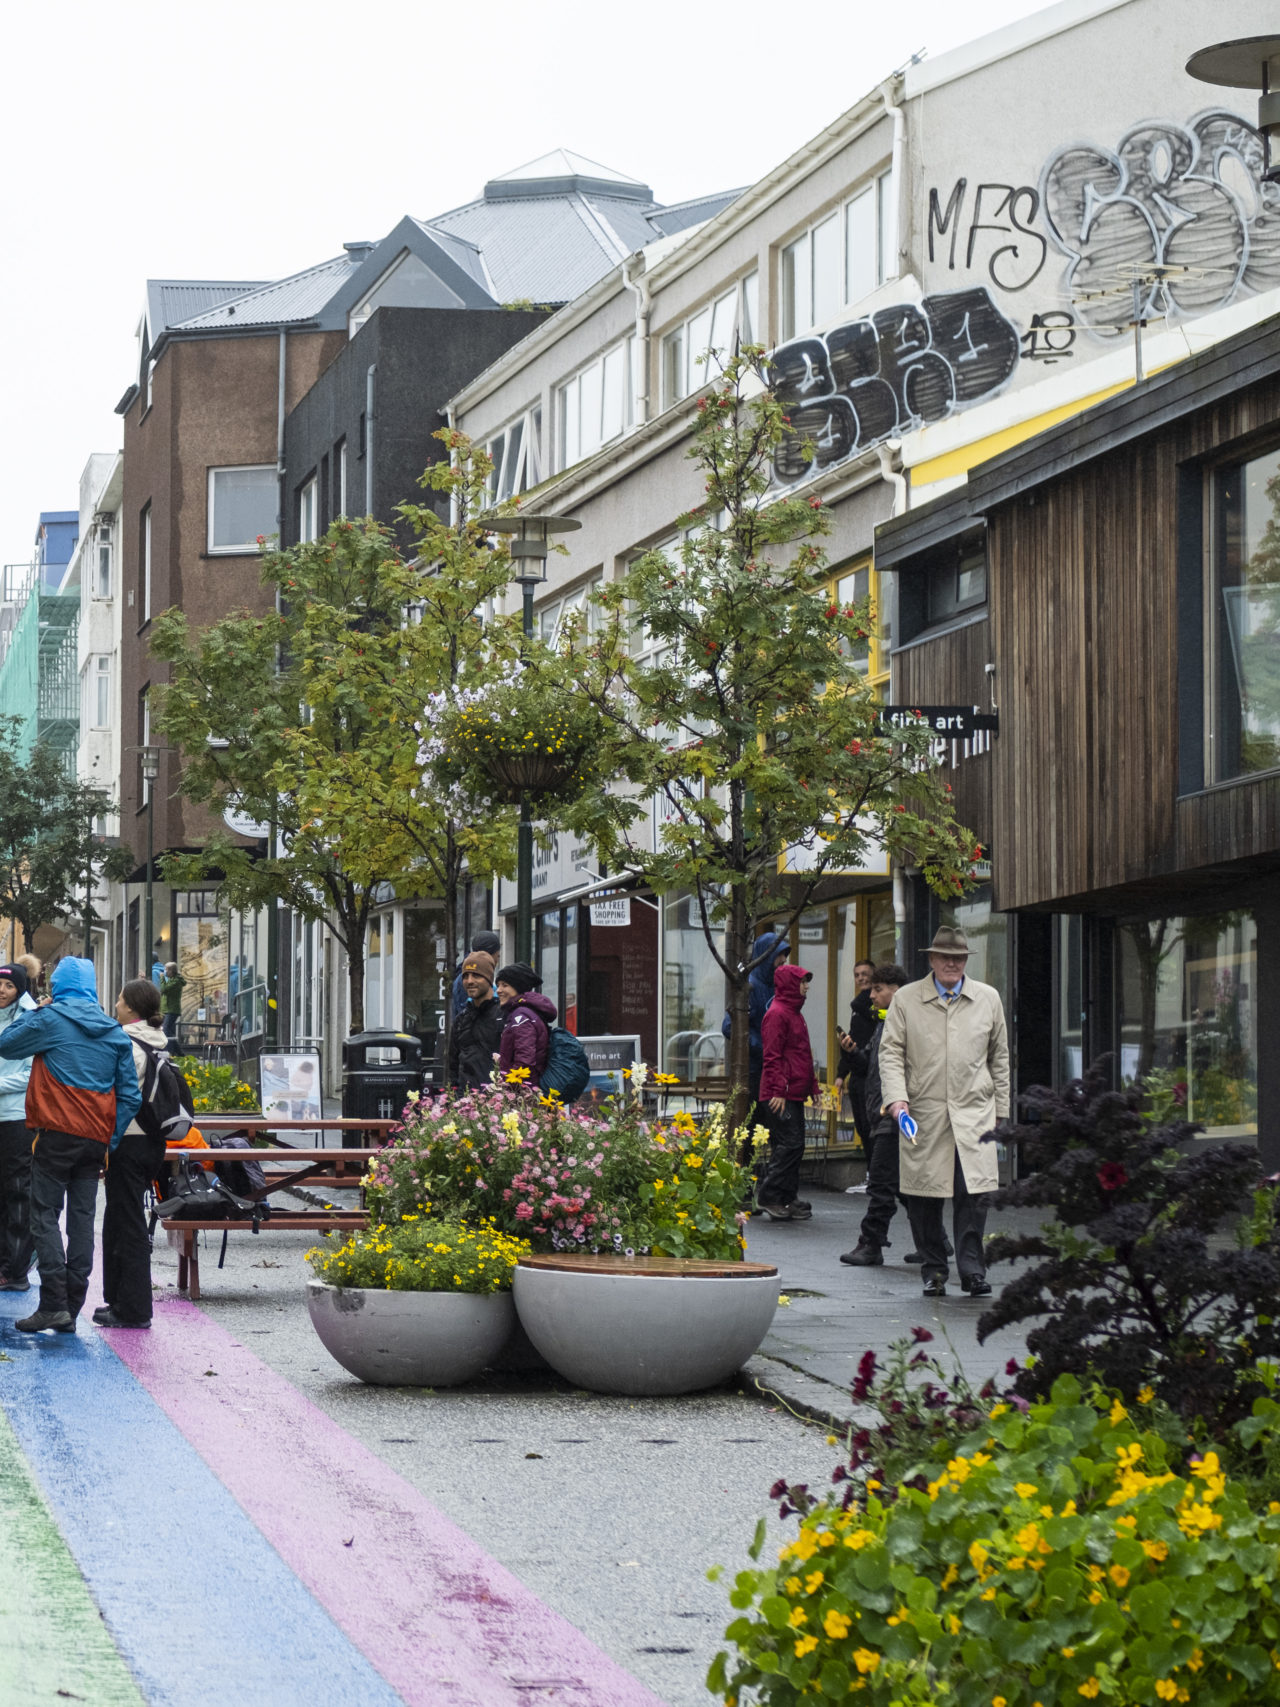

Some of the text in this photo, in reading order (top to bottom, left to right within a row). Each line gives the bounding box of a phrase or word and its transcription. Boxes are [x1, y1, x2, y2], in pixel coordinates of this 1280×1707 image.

[928, 177, 1047, 293] MFS
[935, 714, 964, 729] art
[594, 900, 625, 910] TAX FREE
[594, 911, 626, 919] SHOPPING
[609, 1052, 621, 1060] art
